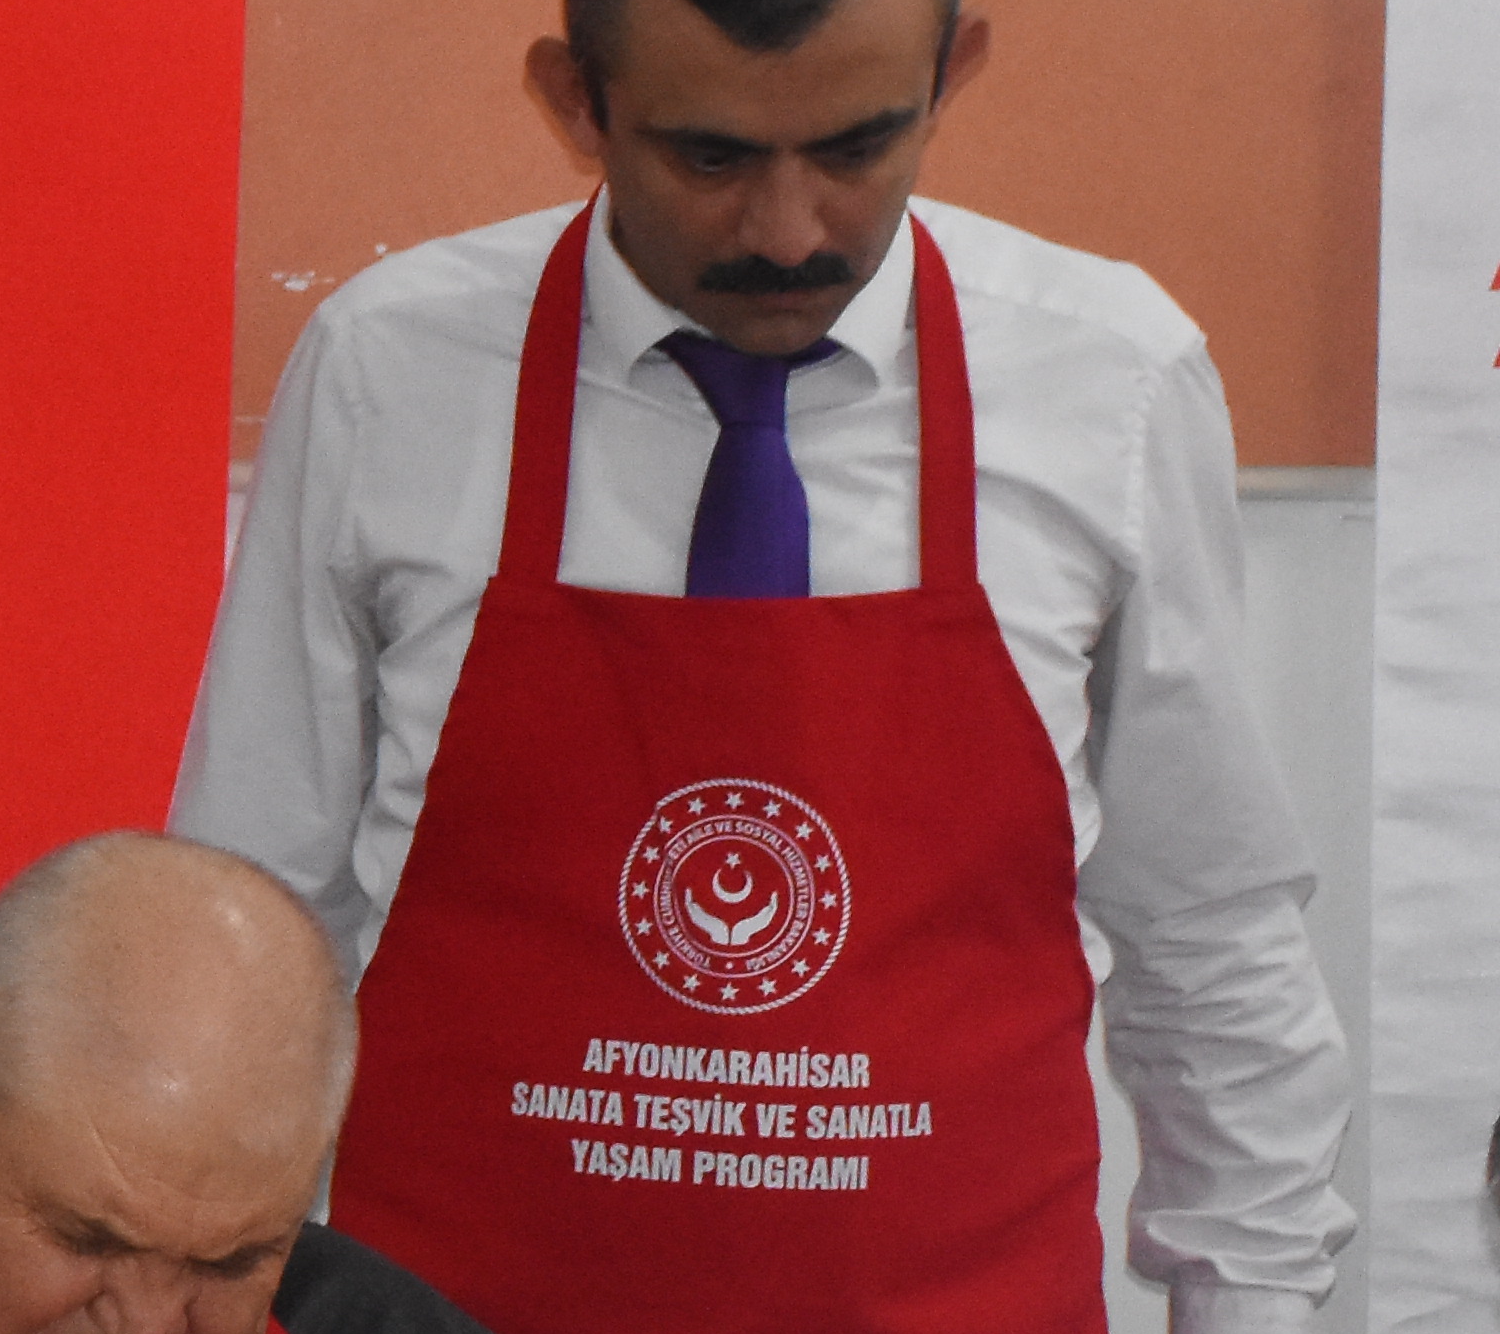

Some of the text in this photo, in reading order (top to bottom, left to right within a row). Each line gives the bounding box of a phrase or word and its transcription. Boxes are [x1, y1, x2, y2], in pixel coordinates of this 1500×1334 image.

[583, 1038, 870, 1088] AFYONKARAHİSAR
[511, 1081, 932, 1140] SANATA TEŞVİK VE SANATLA
[570, 1138, 868, 1191] YAŞAM PROGRAMI
